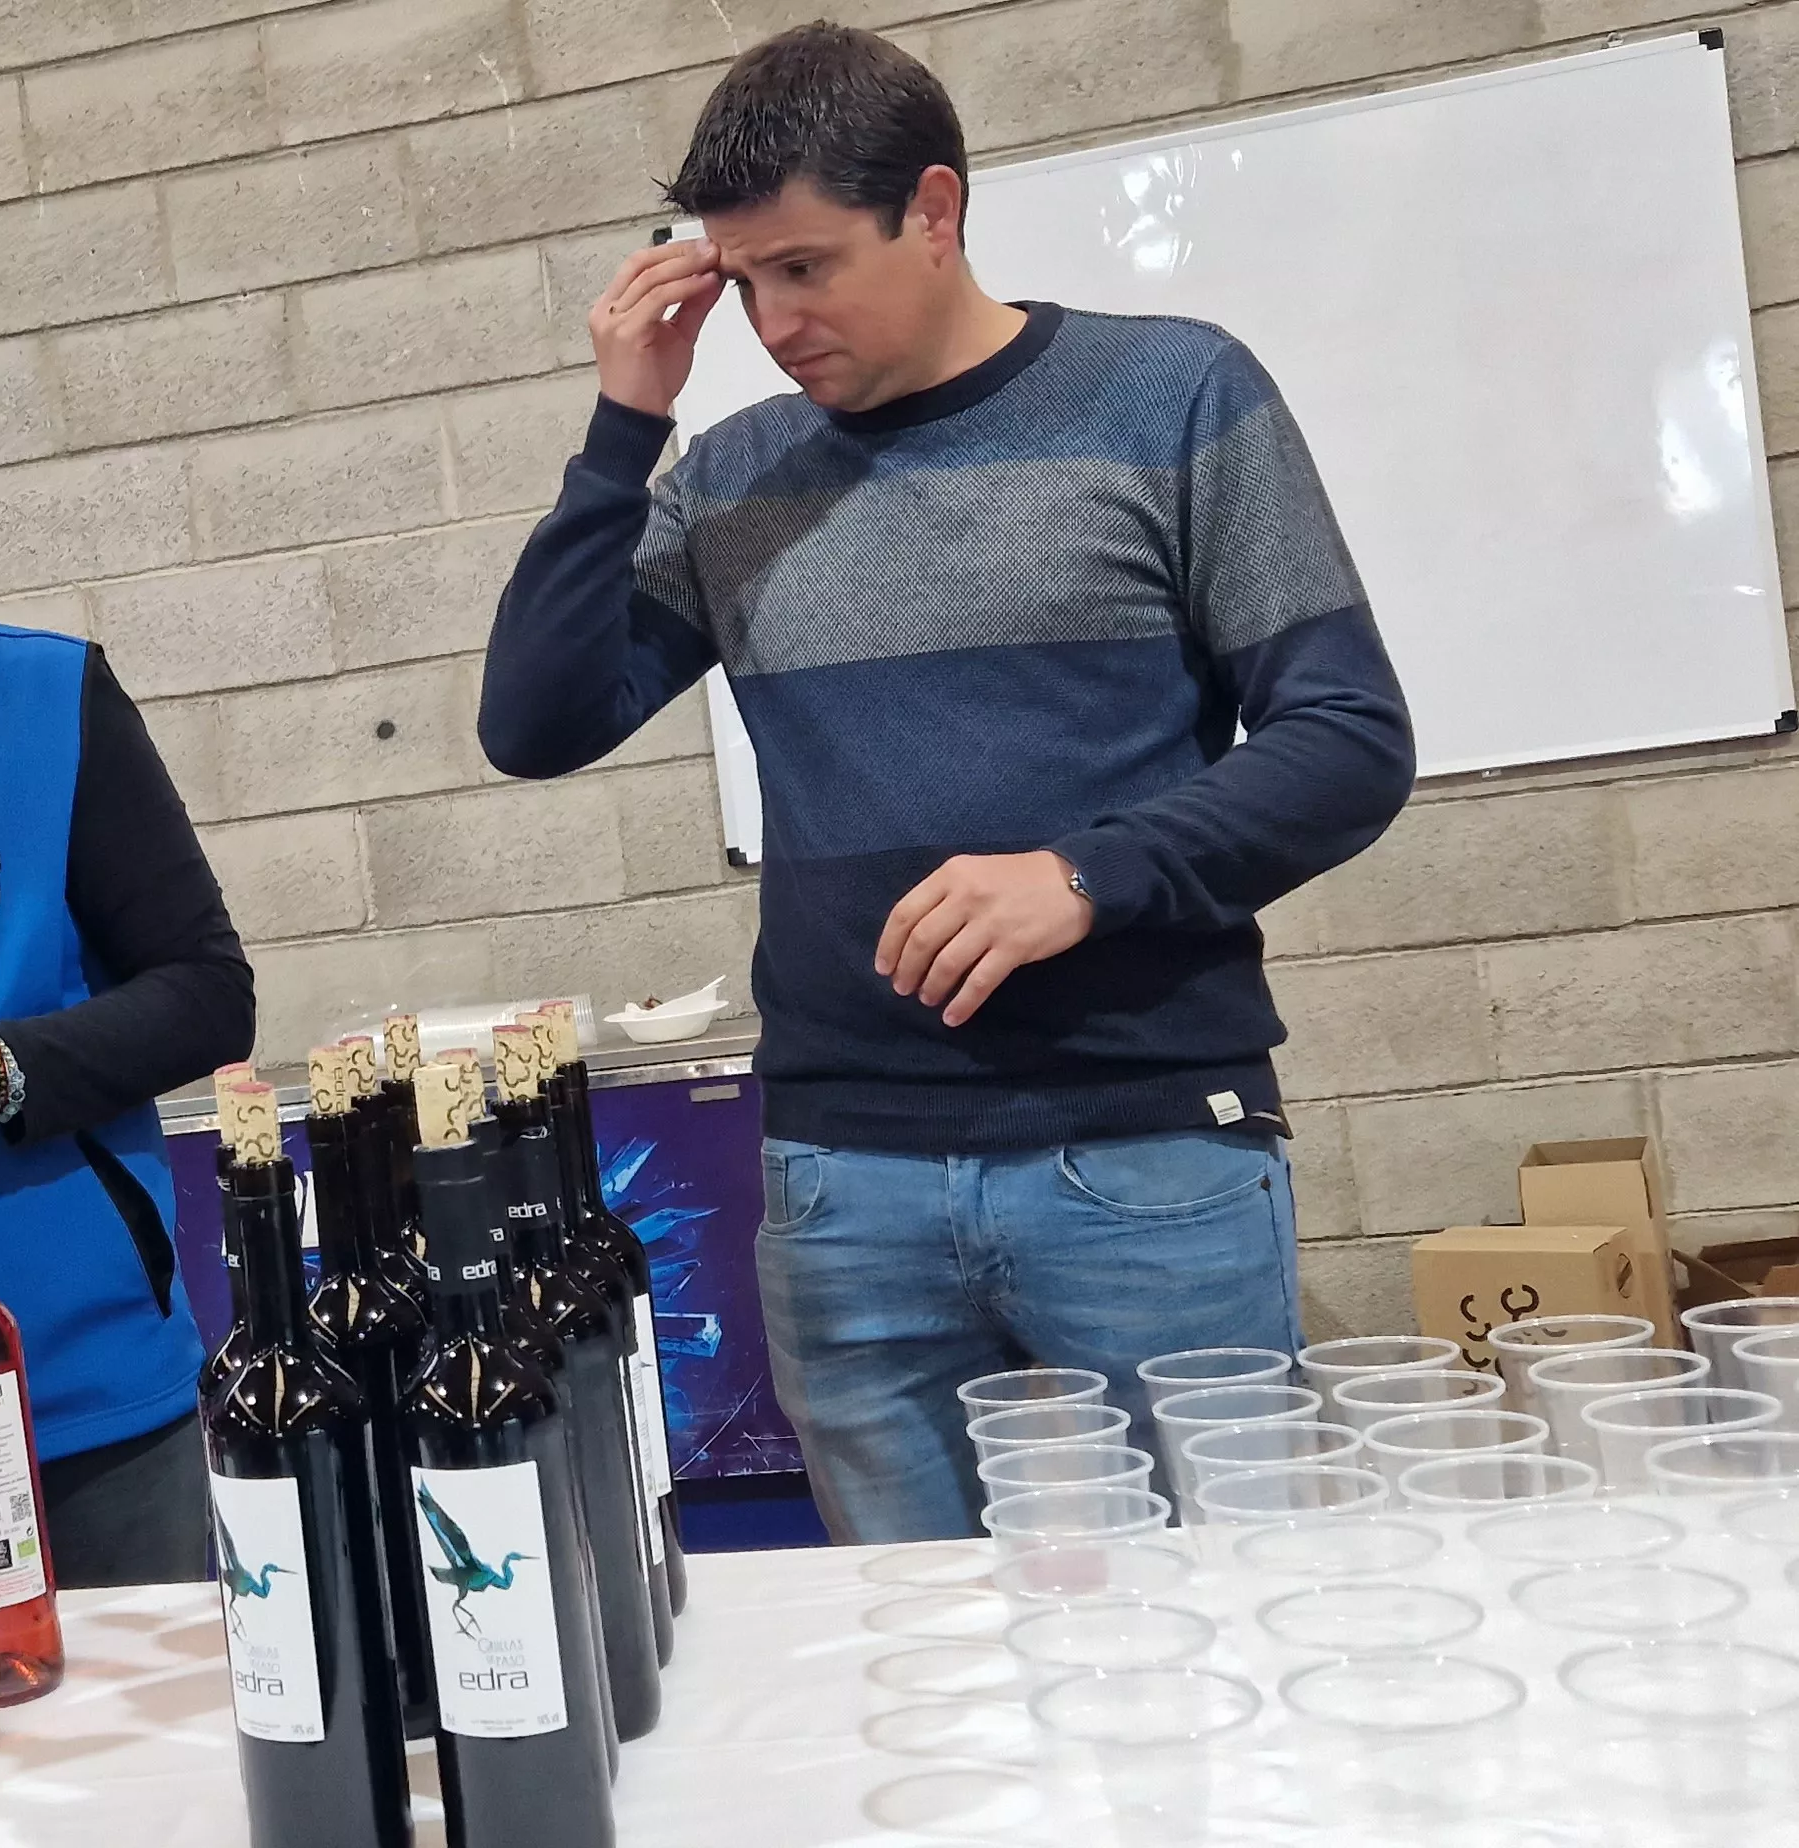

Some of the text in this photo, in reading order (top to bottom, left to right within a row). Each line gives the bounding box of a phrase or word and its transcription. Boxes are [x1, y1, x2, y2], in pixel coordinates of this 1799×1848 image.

[508, 1202, 548, 1218] edra
[235, 1669, 284, 1696] edra
[458, 1667, 529, 1691] edra
